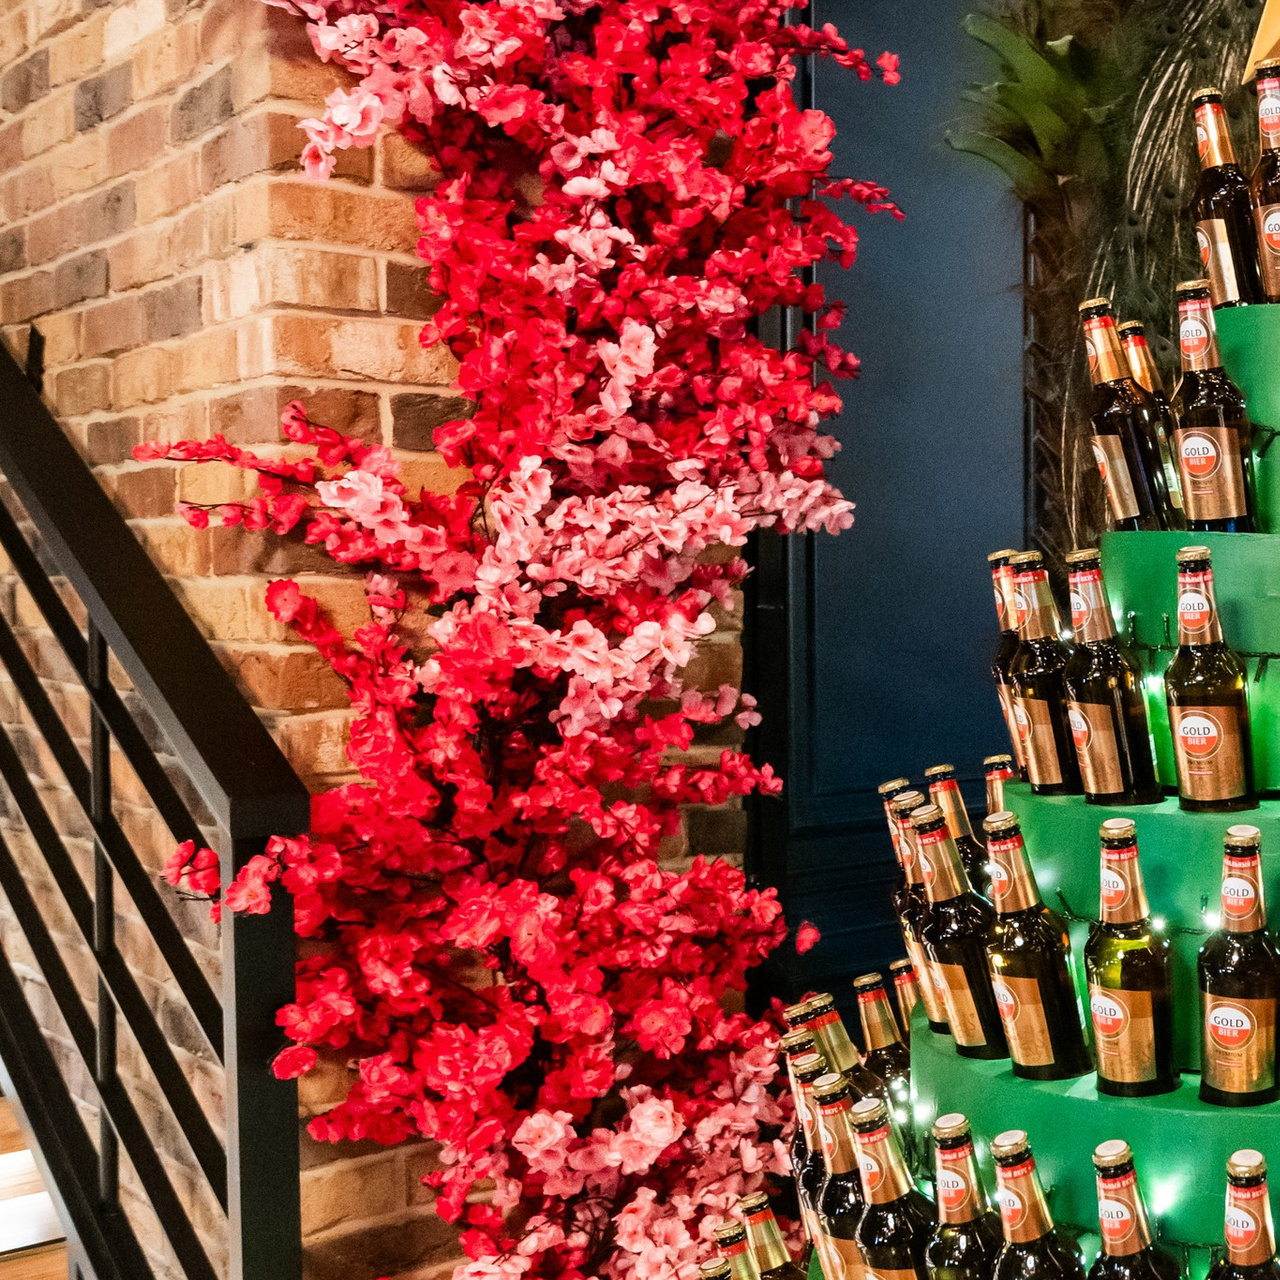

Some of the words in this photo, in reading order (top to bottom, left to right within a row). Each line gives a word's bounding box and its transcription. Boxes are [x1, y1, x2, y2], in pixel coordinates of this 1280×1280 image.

[1181, 328, 1202, 338] GOLD
[1184, 447, 1210, 457] GOLD
[1189, 457, 1207, 466] BIER
[1181, 601, 1204, 612] GOLD
[1182, 726, 1211, 737] GOLD
[1187, 736, 1207, 746] BIER
[1224, 886, 1250, 897] GOLD
[1226, 897, 1245, 907] BIER
[1092, 1003, 1117, 1017] GOLD
[1213, 1016, 1244, 1028] GOLD
[1218, 1027, 1239, 1038] BIER
